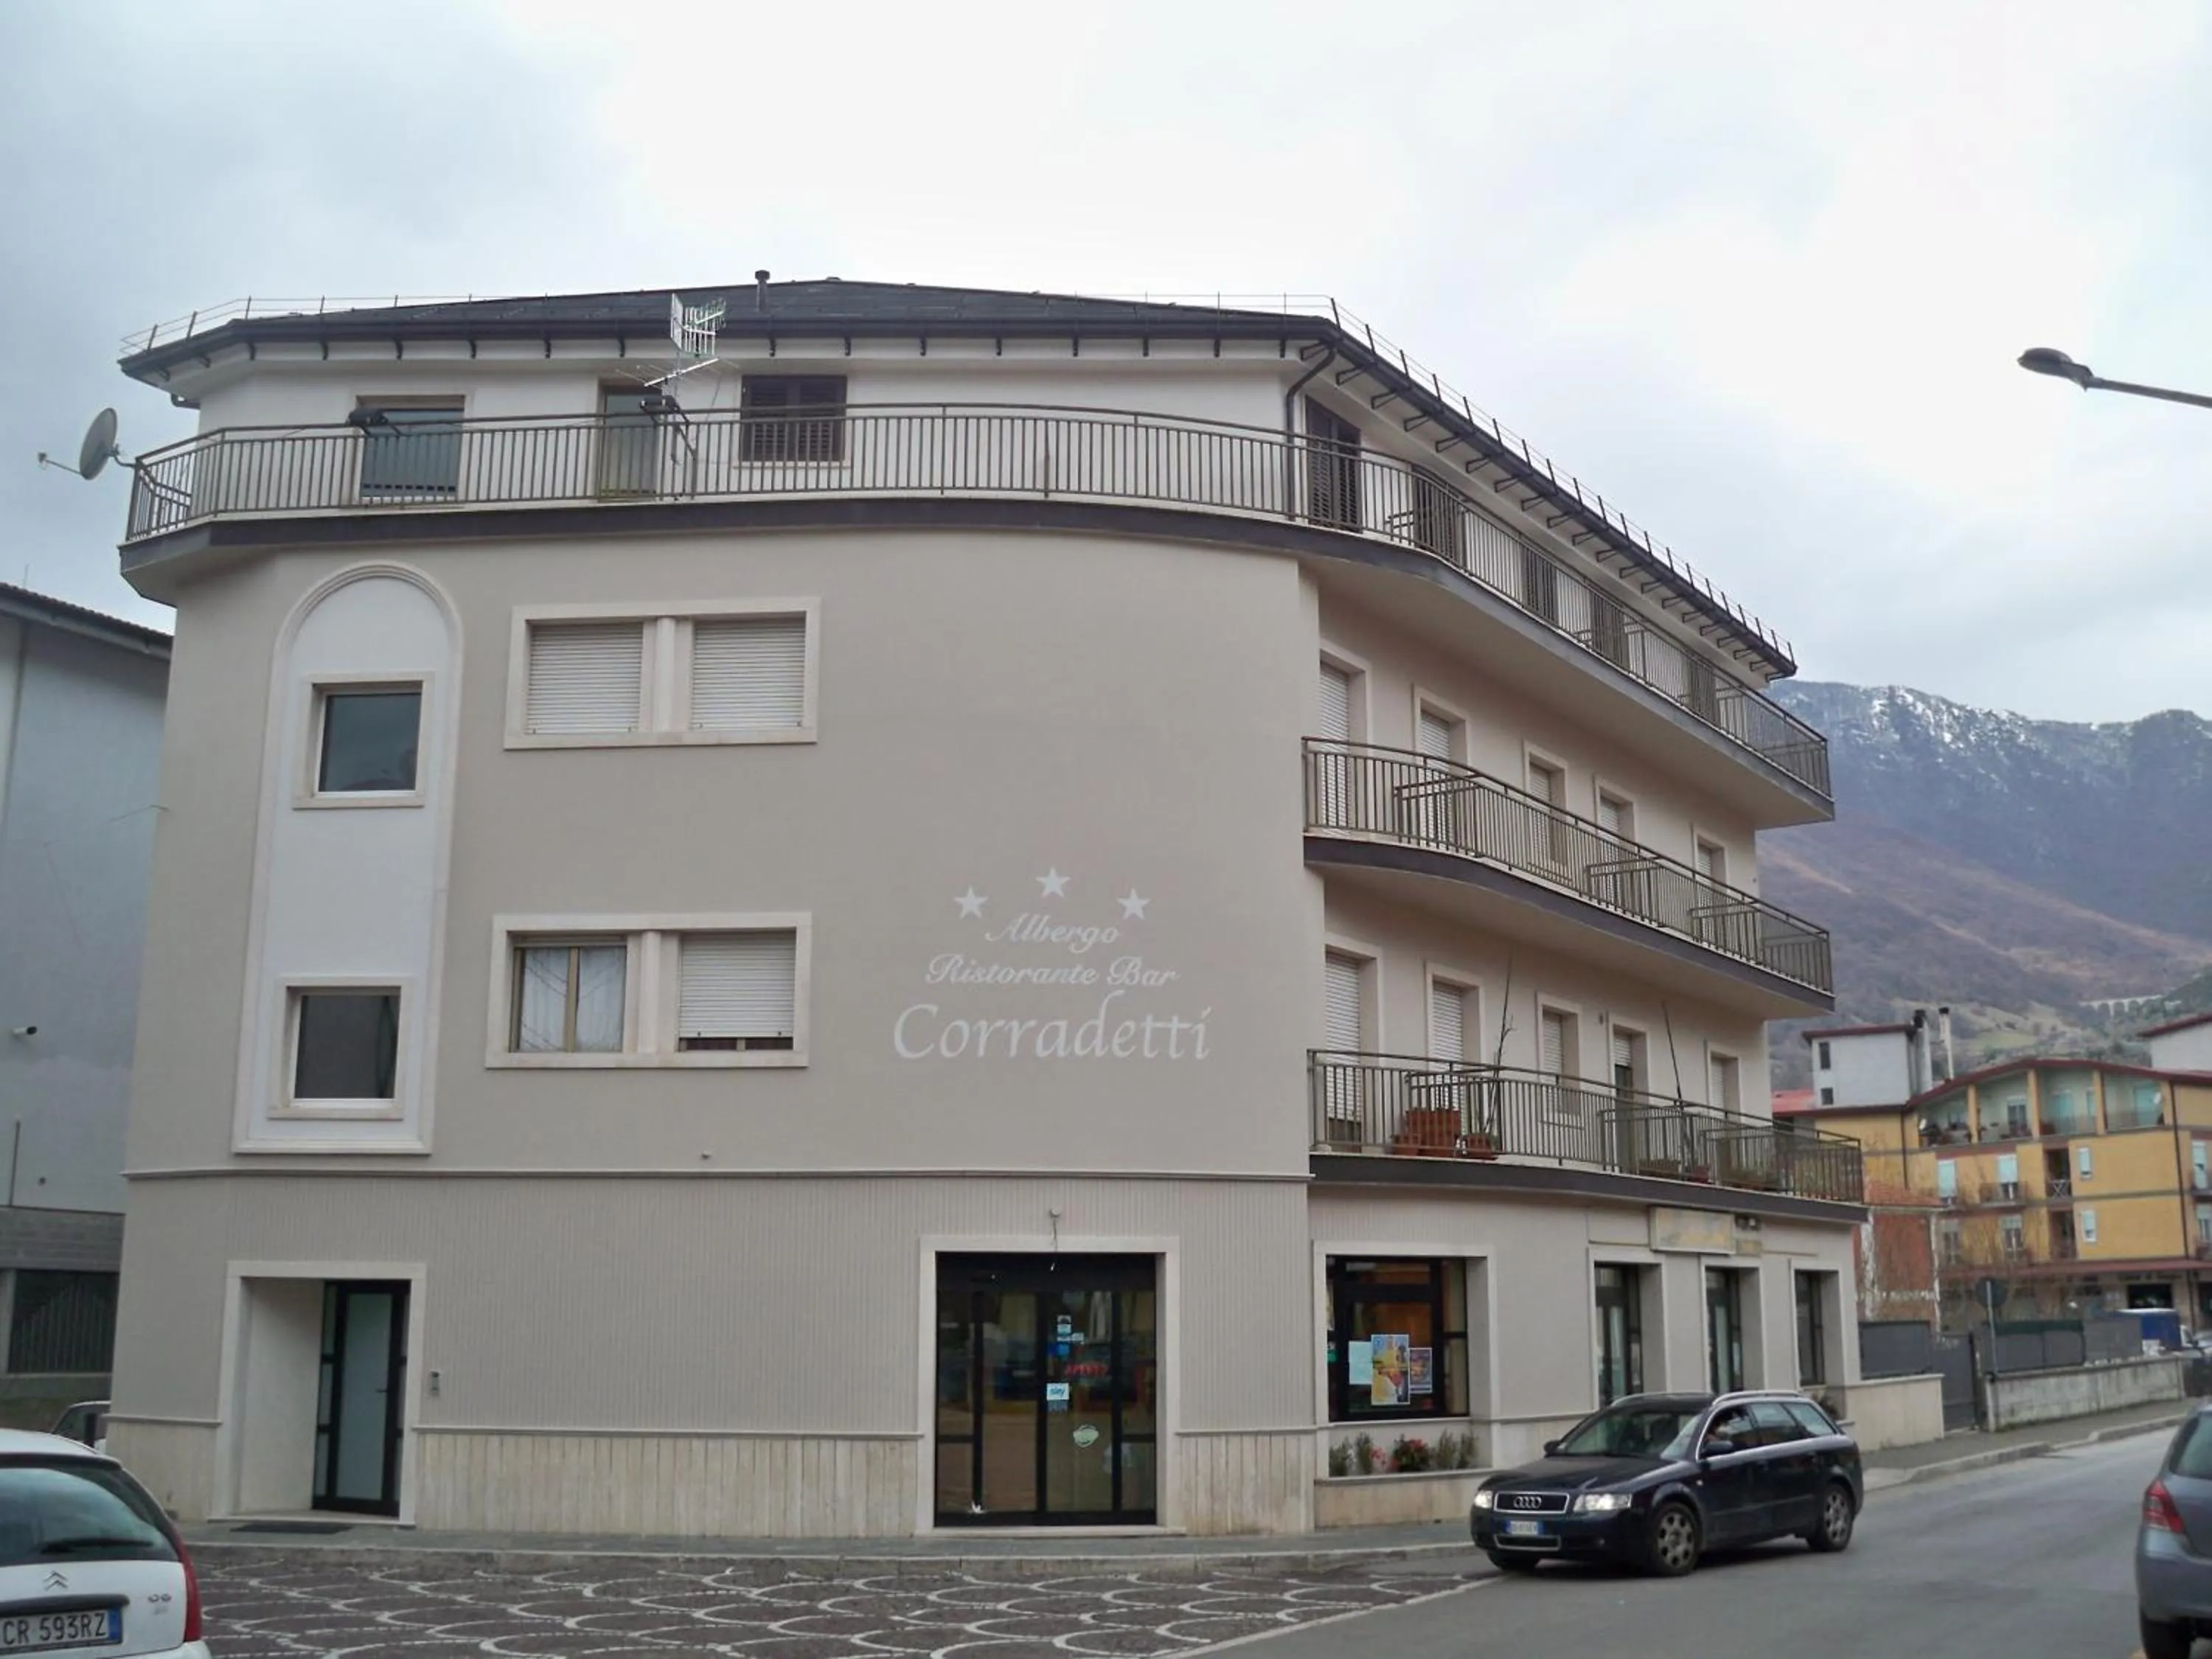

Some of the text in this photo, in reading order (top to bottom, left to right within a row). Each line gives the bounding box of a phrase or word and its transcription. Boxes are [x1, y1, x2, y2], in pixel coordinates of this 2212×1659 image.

[984, 913, 1119, 953] Albergo
[925, 953, 1180, 987] Ristorante Bar
[893, 989, 1213, 1060] Corradetti
[2, 1619, 29, 1645] CR
